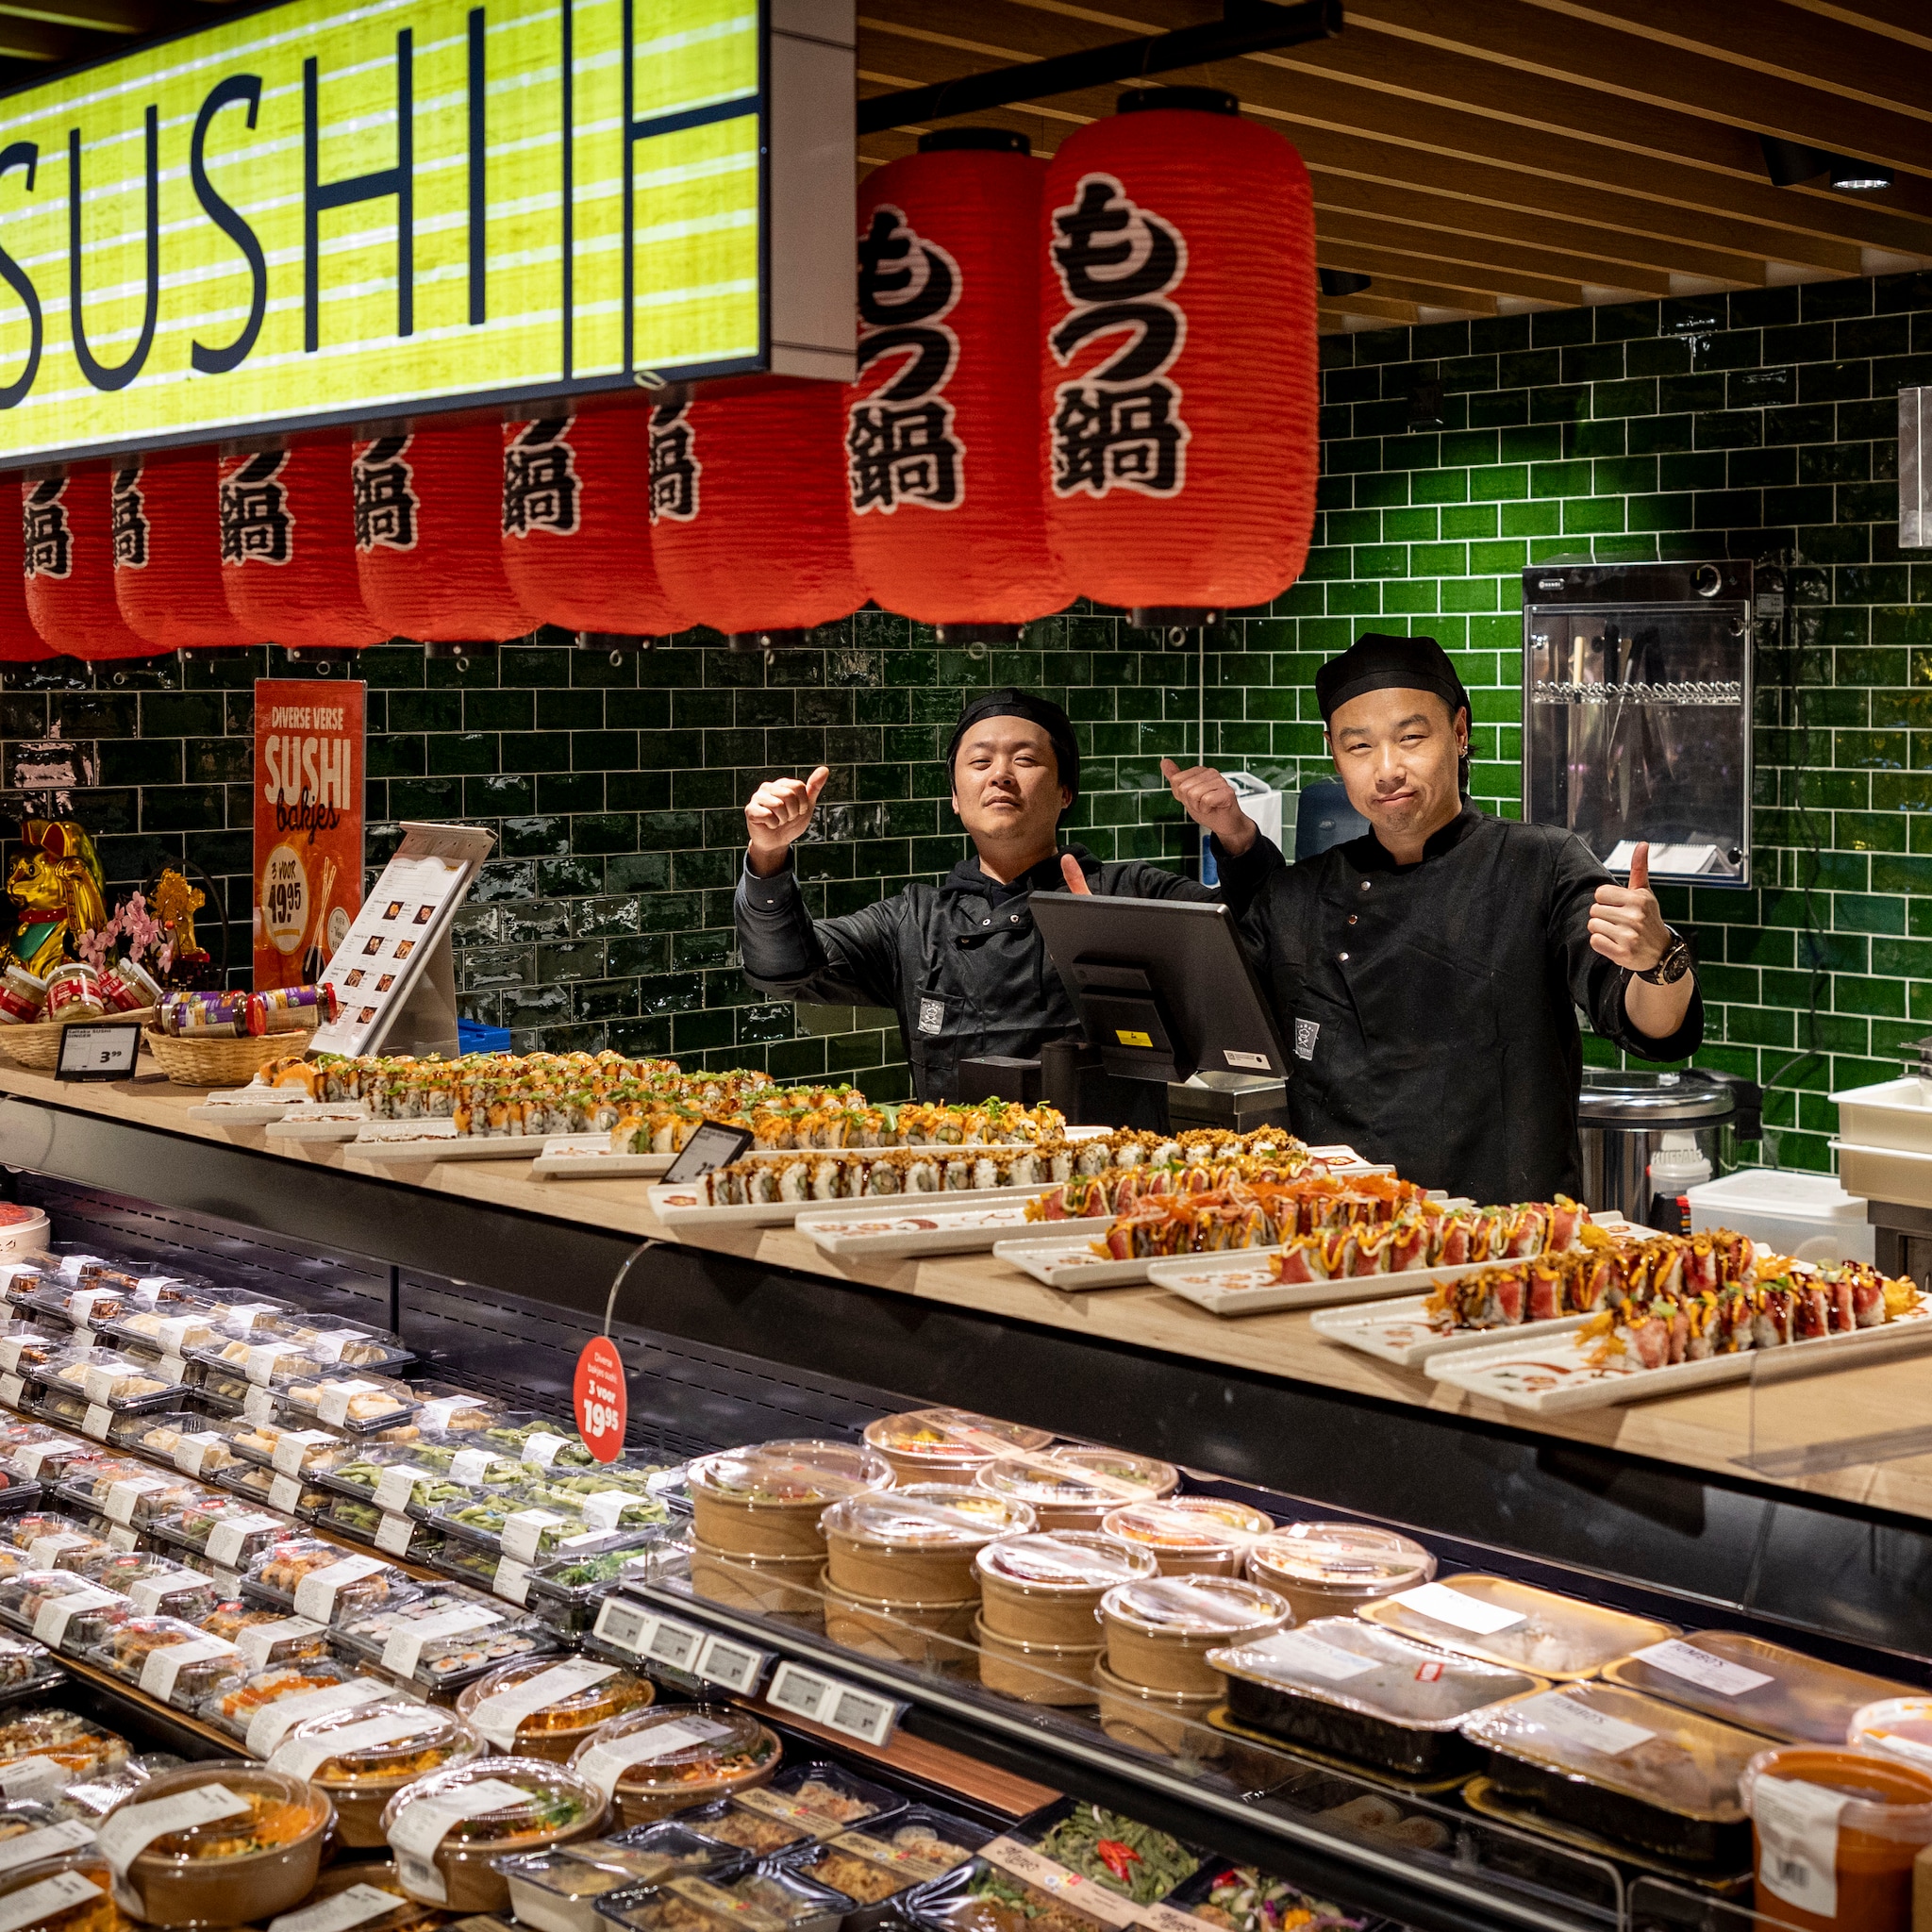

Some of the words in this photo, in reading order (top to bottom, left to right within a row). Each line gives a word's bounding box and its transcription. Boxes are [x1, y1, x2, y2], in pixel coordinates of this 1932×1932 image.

[0, 7, 486, 410] SUSHI
[846, 204, 967, 514] もつ鍋
[1049, 173, 1191, 498] もつ鍋
[272, 707, 311, 729] DIVERSE
[312, 708, 343, 730] VERSE
[264, 735, 351, 809] SUSHI
[276, 787, 340, 845] bakjes
[272, 862, 276, 880] 3
[279, 860, 296, 880] VOOR
[594, 1351, 613, 1369] Diverse
[589, 1379, 595, 1395] 3
[596, 1385, 616, 1405] voor
